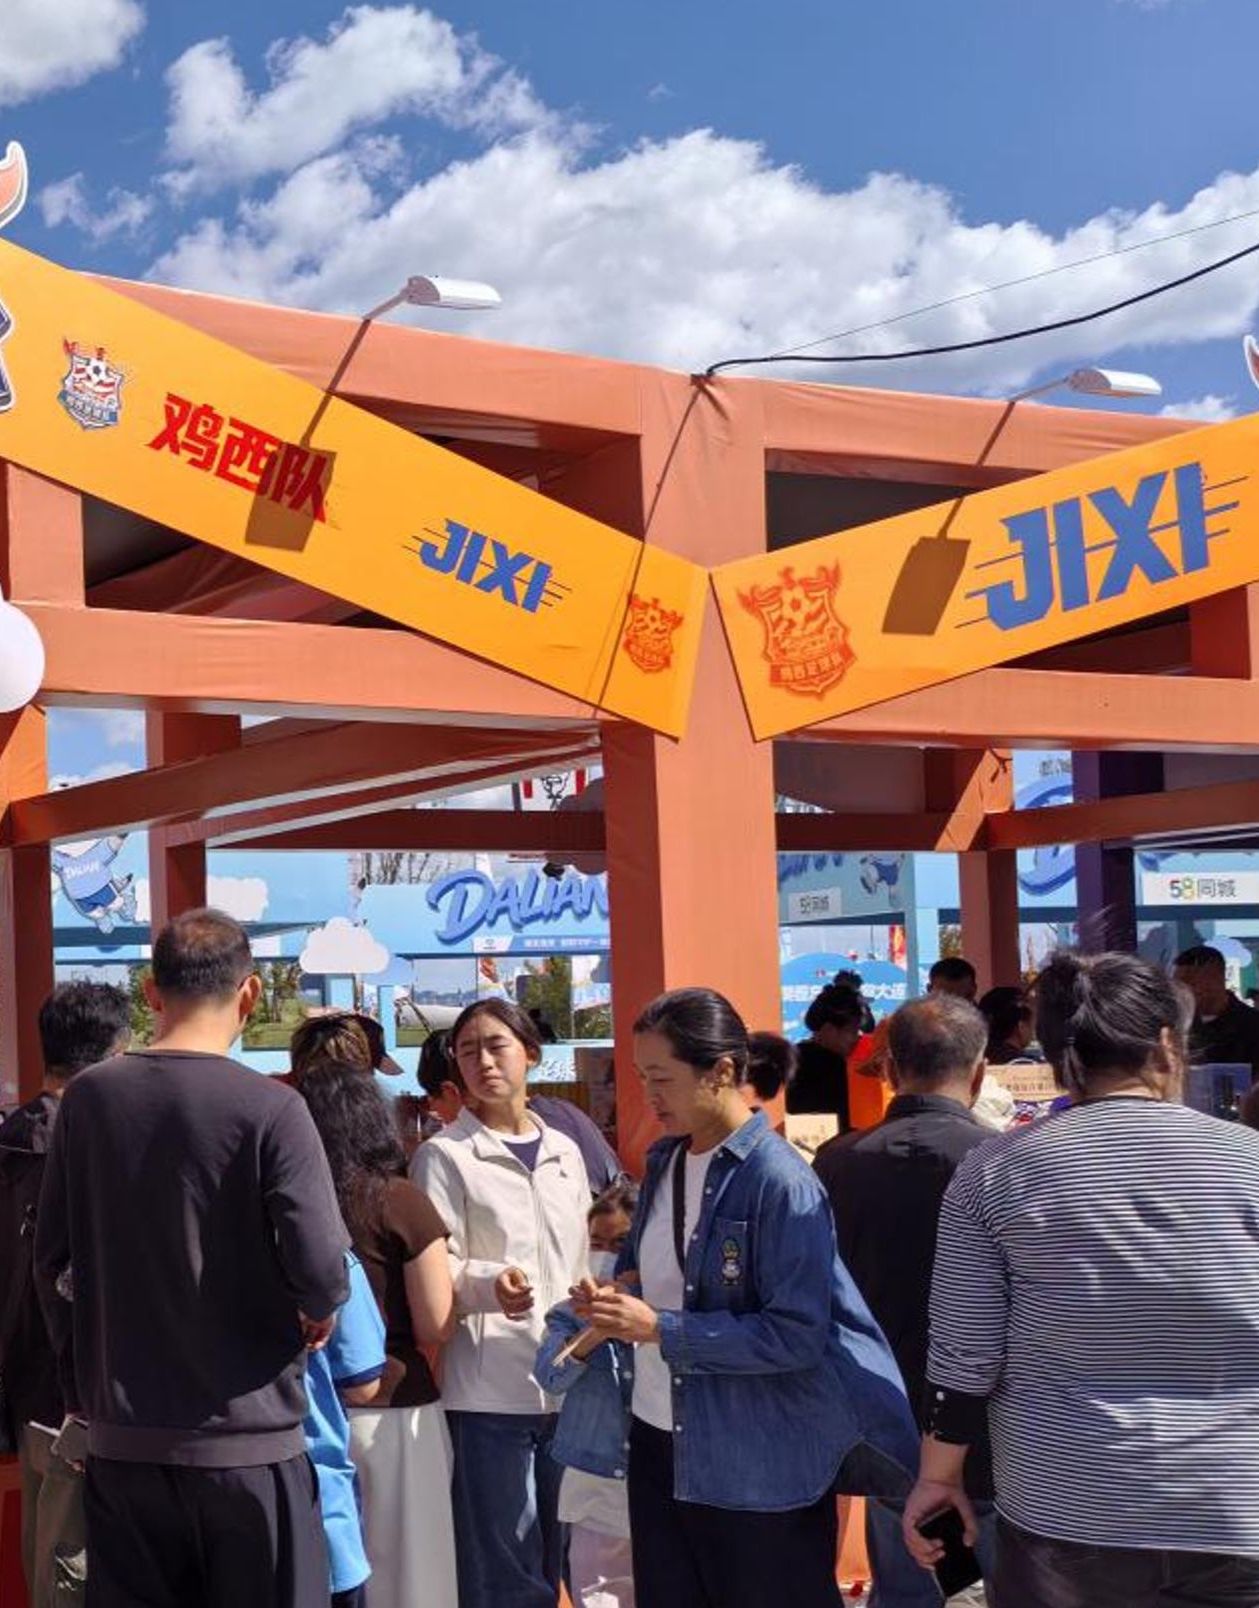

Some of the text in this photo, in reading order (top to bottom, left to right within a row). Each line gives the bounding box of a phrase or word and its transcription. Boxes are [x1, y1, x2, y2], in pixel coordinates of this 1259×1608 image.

[144, 392, 327, 524] 鸡西队
[418, 517, 553, 614] JIXI
[984, 461, 1211, 632] JIXI
[1169, 877, 1237, 901] 58同城
